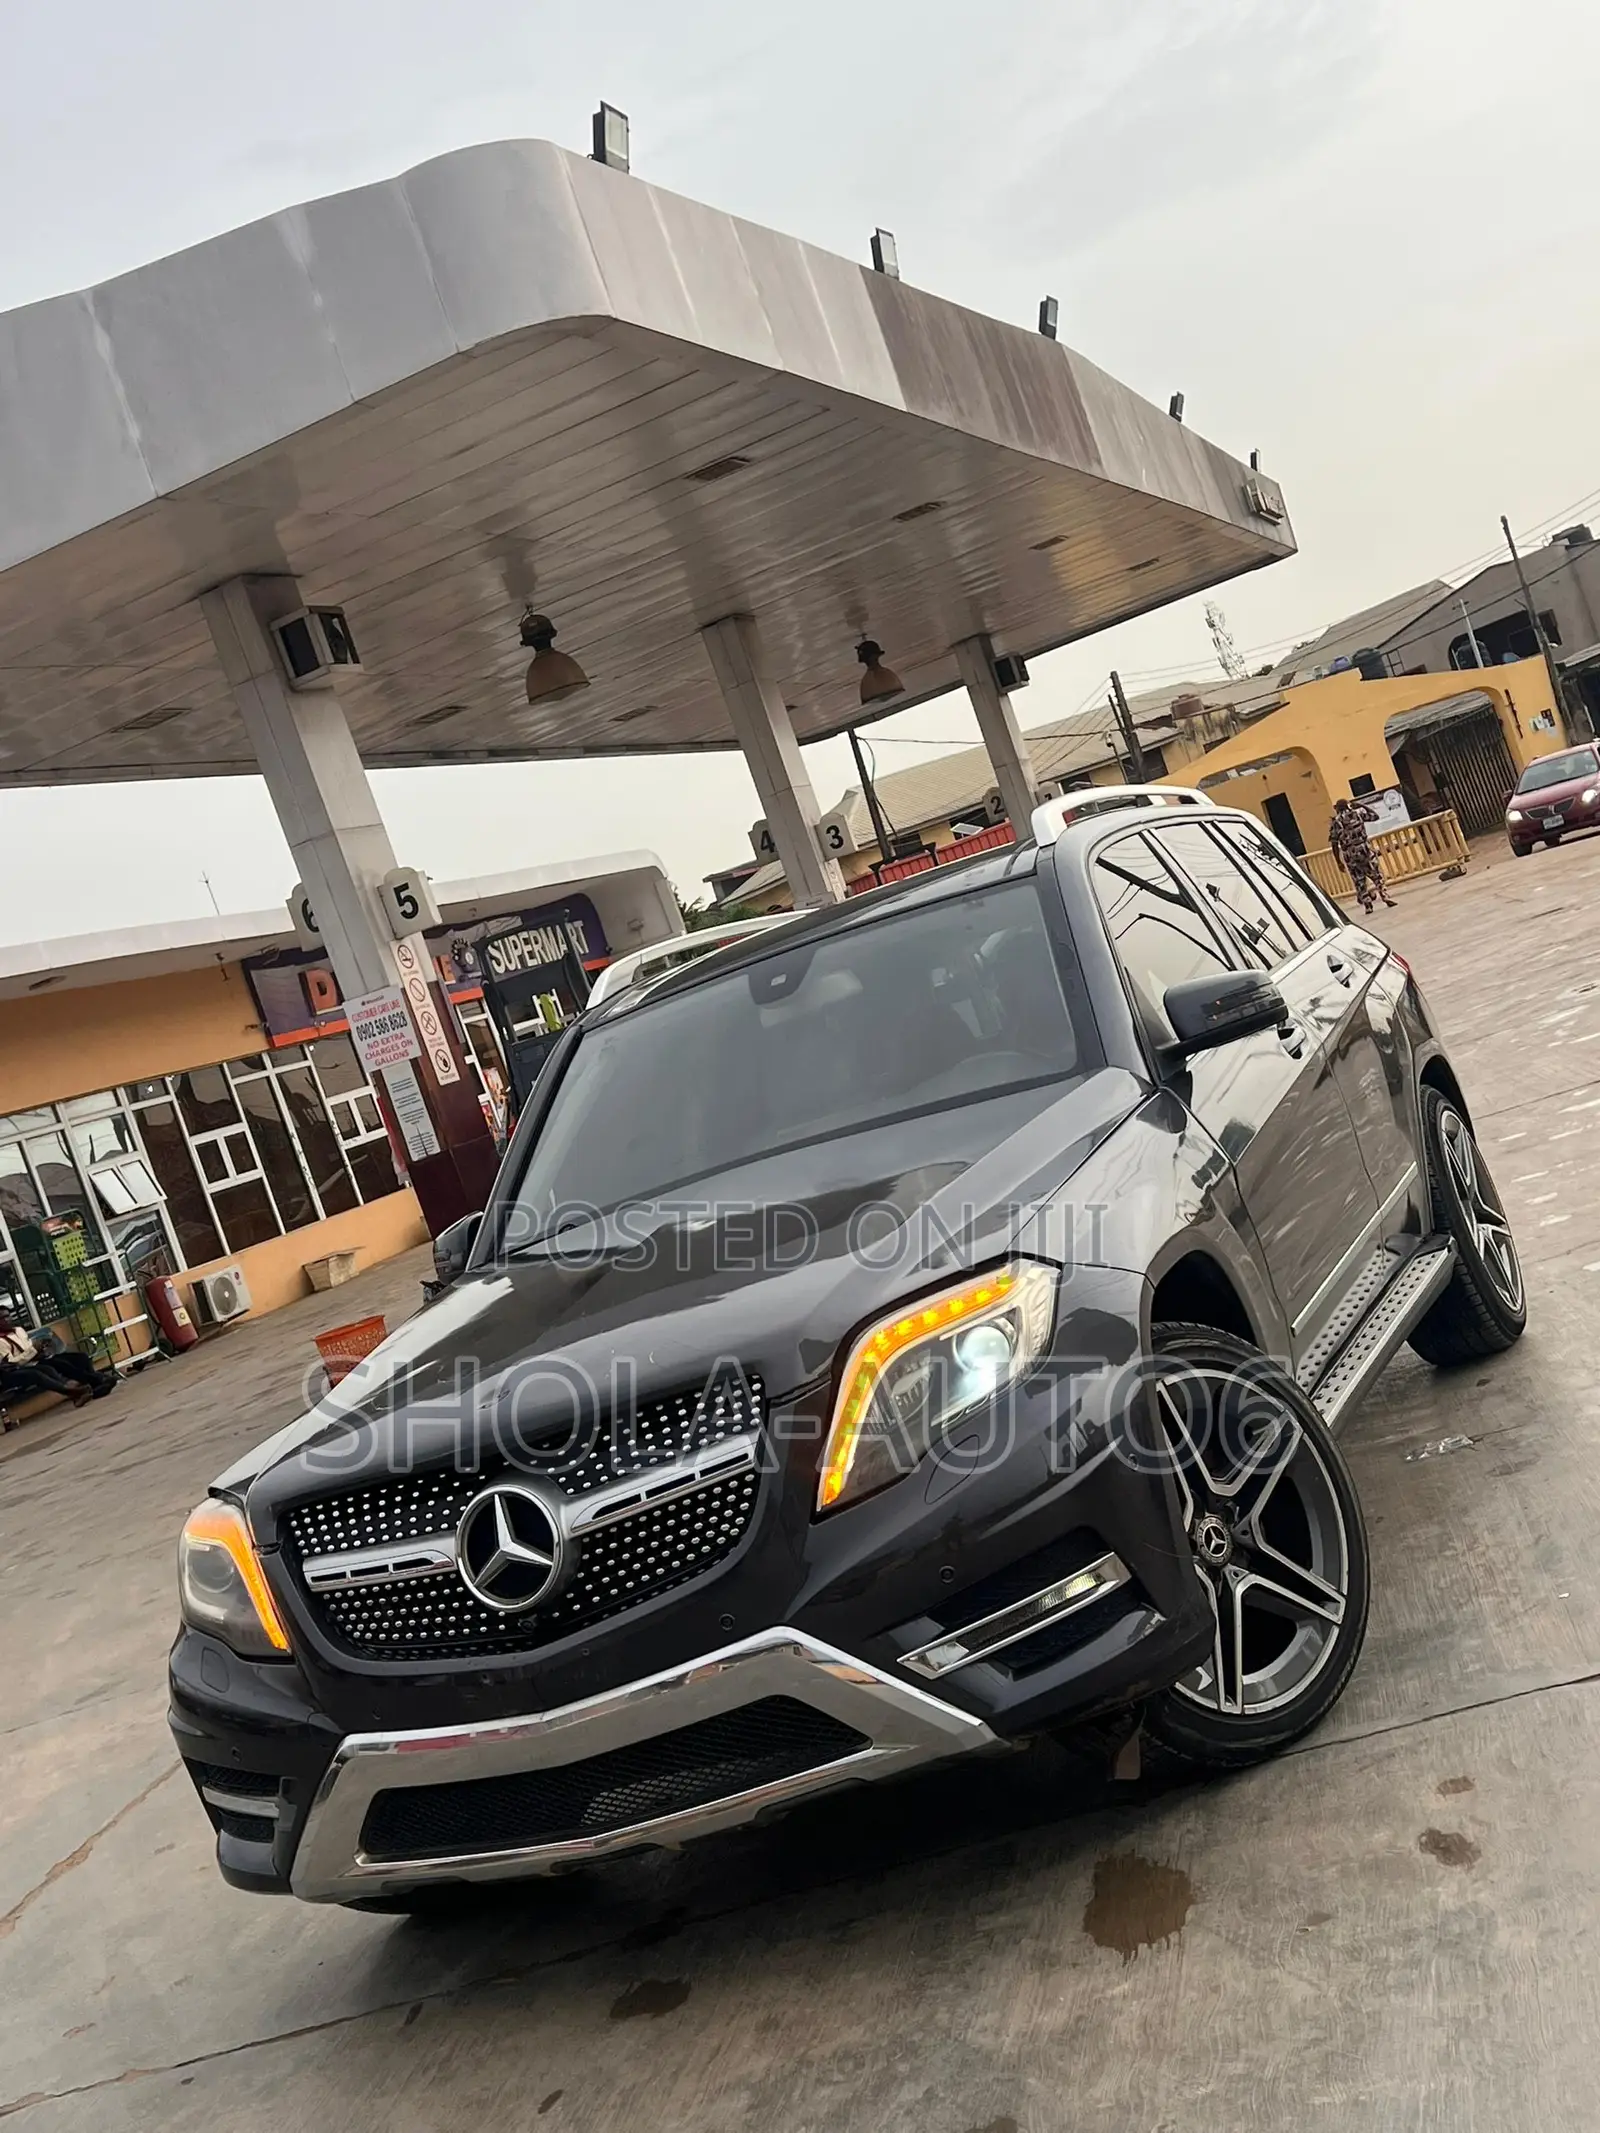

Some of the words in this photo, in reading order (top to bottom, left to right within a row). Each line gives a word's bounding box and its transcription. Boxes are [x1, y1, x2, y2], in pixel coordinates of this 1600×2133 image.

[991, 796, 1004, 815] 2
[760, 829, 776, 853] 4
[826, 825, 844, 850] 3
[393, 882, 419, 919] 5
[364, 1044, 401, 1061] CHARGES
[401, 1039, 414, 1049] ON
[367, 1040, 379, 1051] NO
[381, 1032, 405, 1046] EXTRA
[374, 1049, 410, 1067] GALLONS
